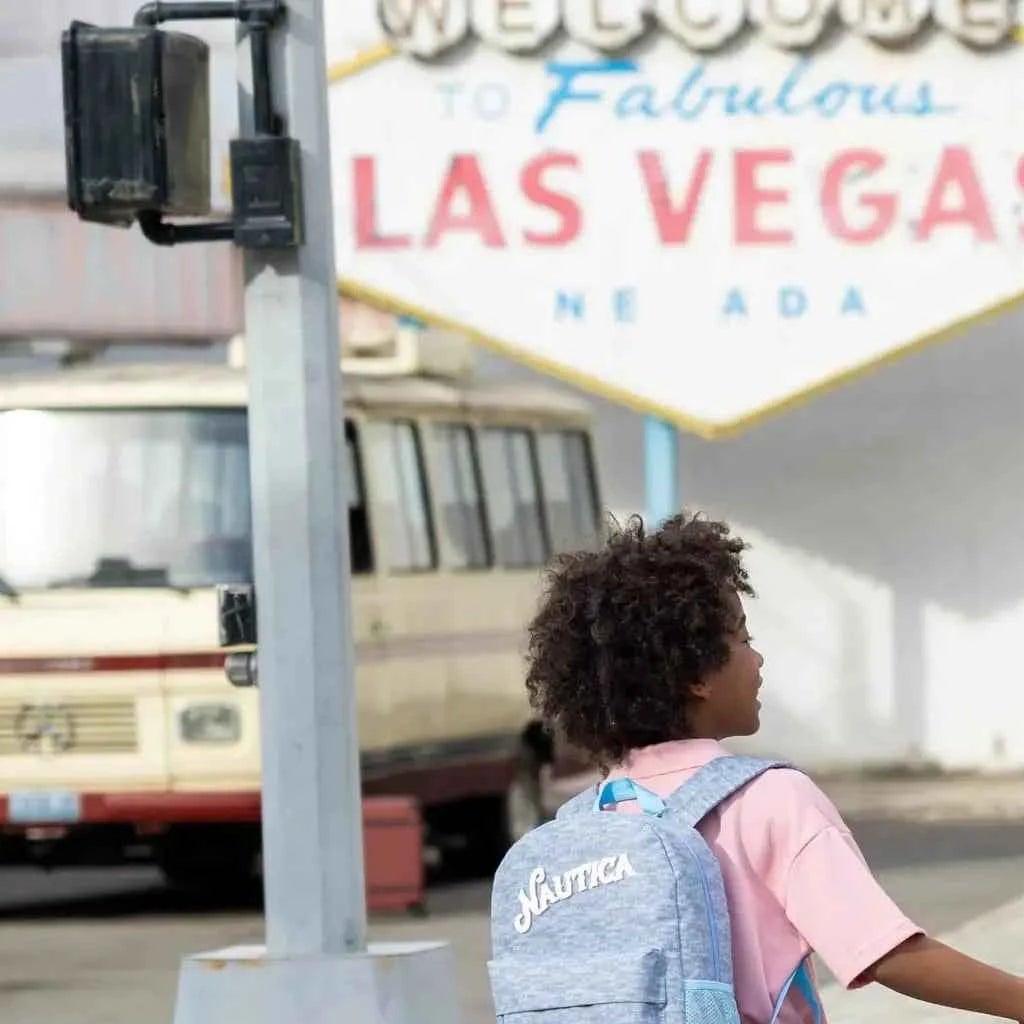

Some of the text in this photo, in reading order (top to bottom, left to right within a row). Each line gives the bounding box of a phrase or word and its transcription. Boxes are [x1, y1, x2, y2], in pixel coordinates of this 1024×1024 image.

[433, 57, 952, 135] TO Fabulous
[351, 152, 584, 250] LAS
[513, 852, 636, 934] NAUTICA
